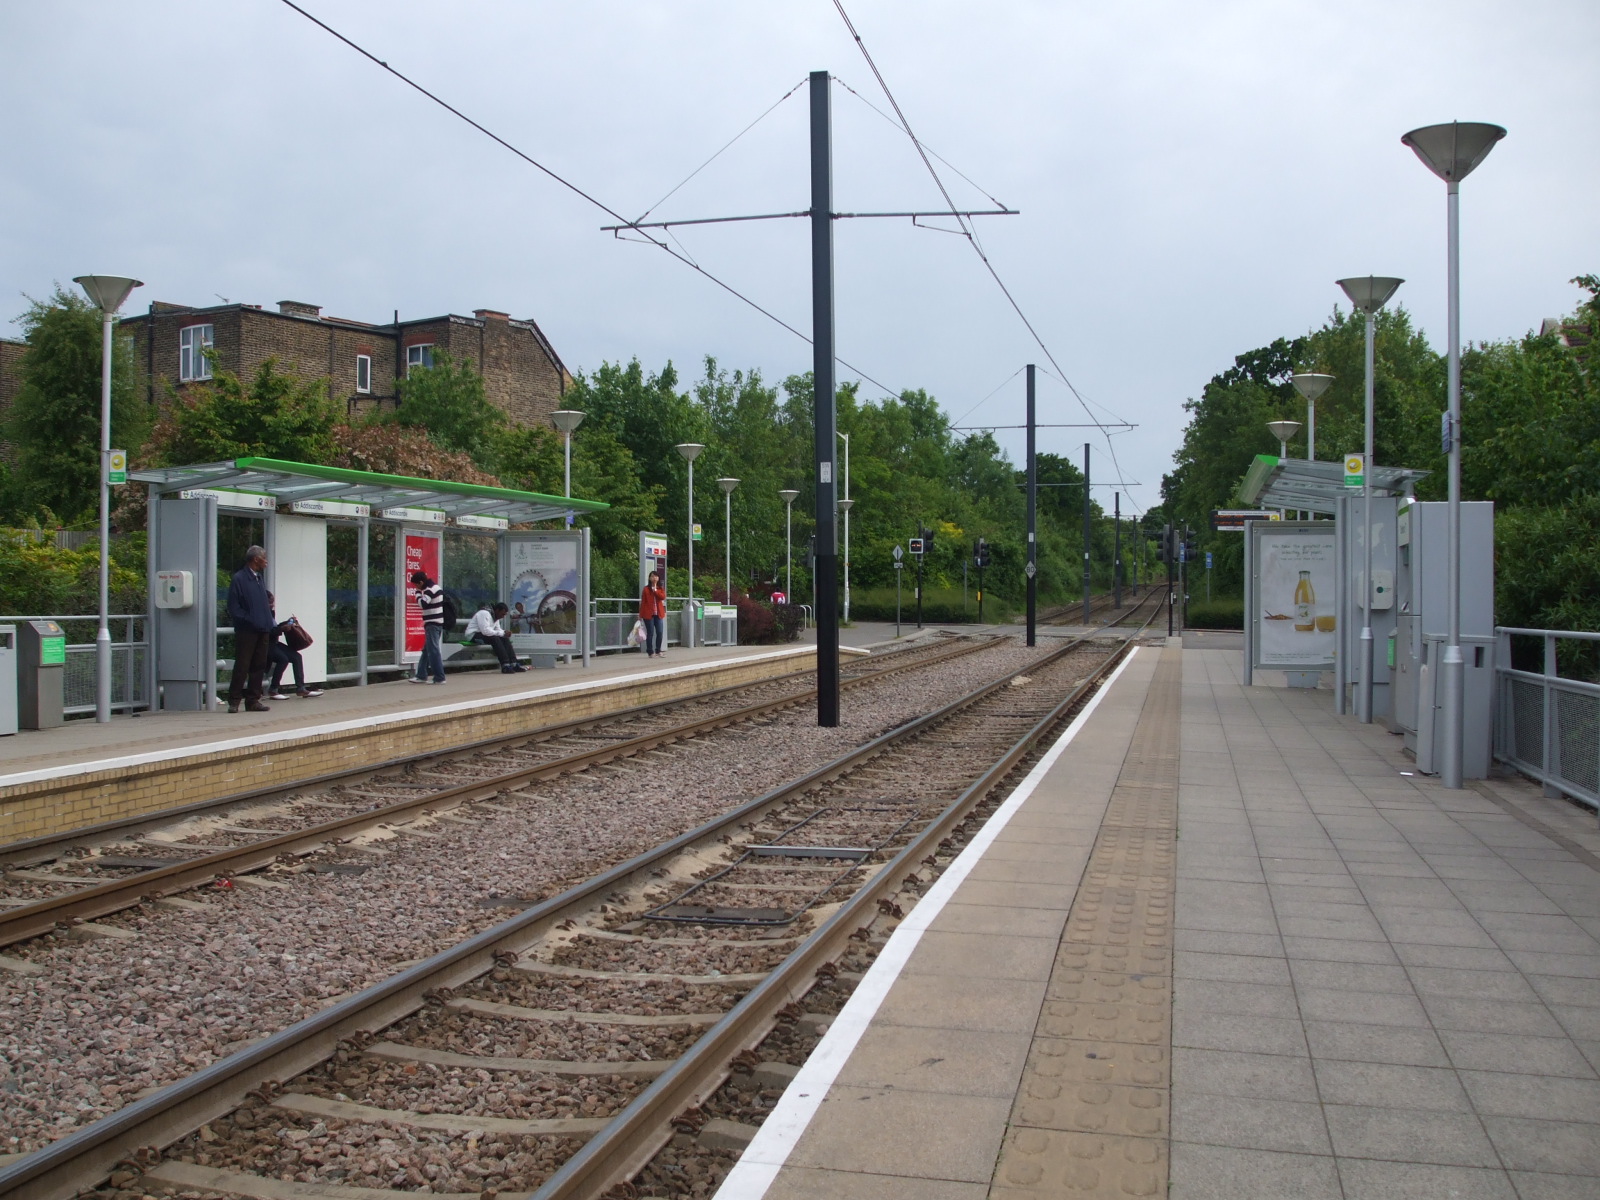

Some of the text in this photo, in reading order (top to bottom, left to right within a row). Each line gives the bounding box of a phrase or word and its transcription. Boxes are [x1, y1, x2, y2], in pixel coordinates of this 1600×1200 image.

[190, 491, 219, 500] Addiscombe
[300, 502, 324, 511] Addiscombe
[388, 509, 408, 518] Addiscombe
[406, 545, 423, 560] Cheap
